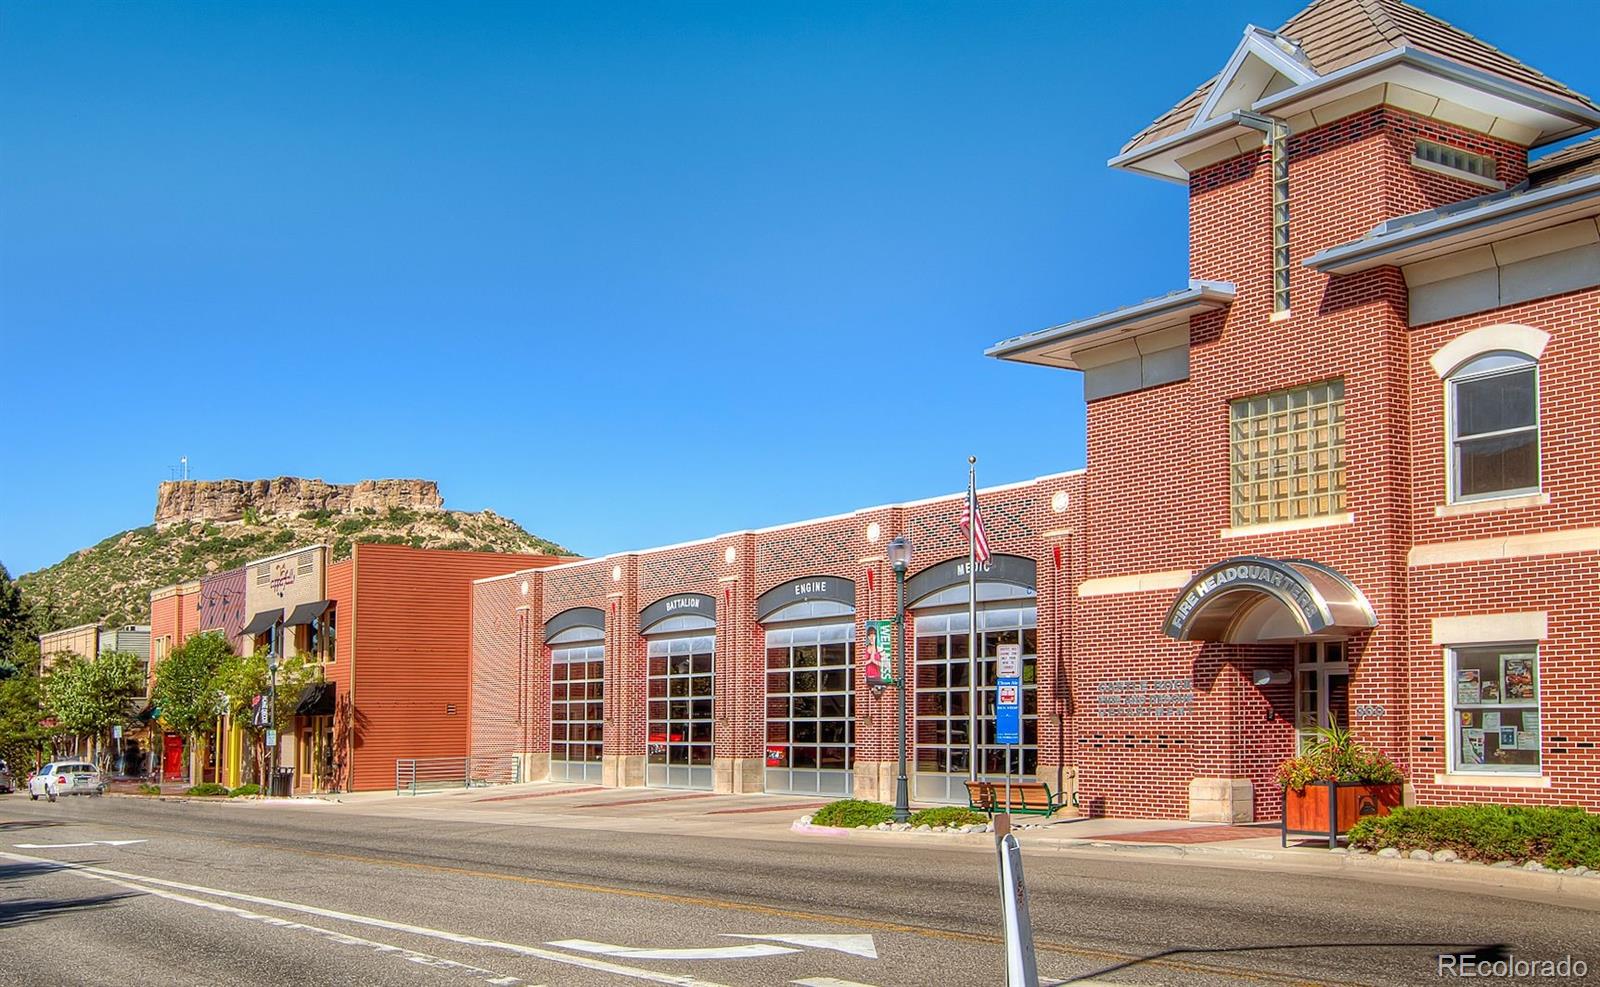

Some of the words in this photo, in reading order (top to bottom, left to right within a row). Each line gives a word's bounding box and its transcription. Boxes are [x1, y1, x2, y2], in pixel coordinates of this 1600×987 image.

[795, 581, 827, 596] ENGINE
[666, 598, 700, 612] BATTALION
[1172, 591, 1199, 630] FIRE
[1197, 565, 1318, 618] HEADQUARTERS
